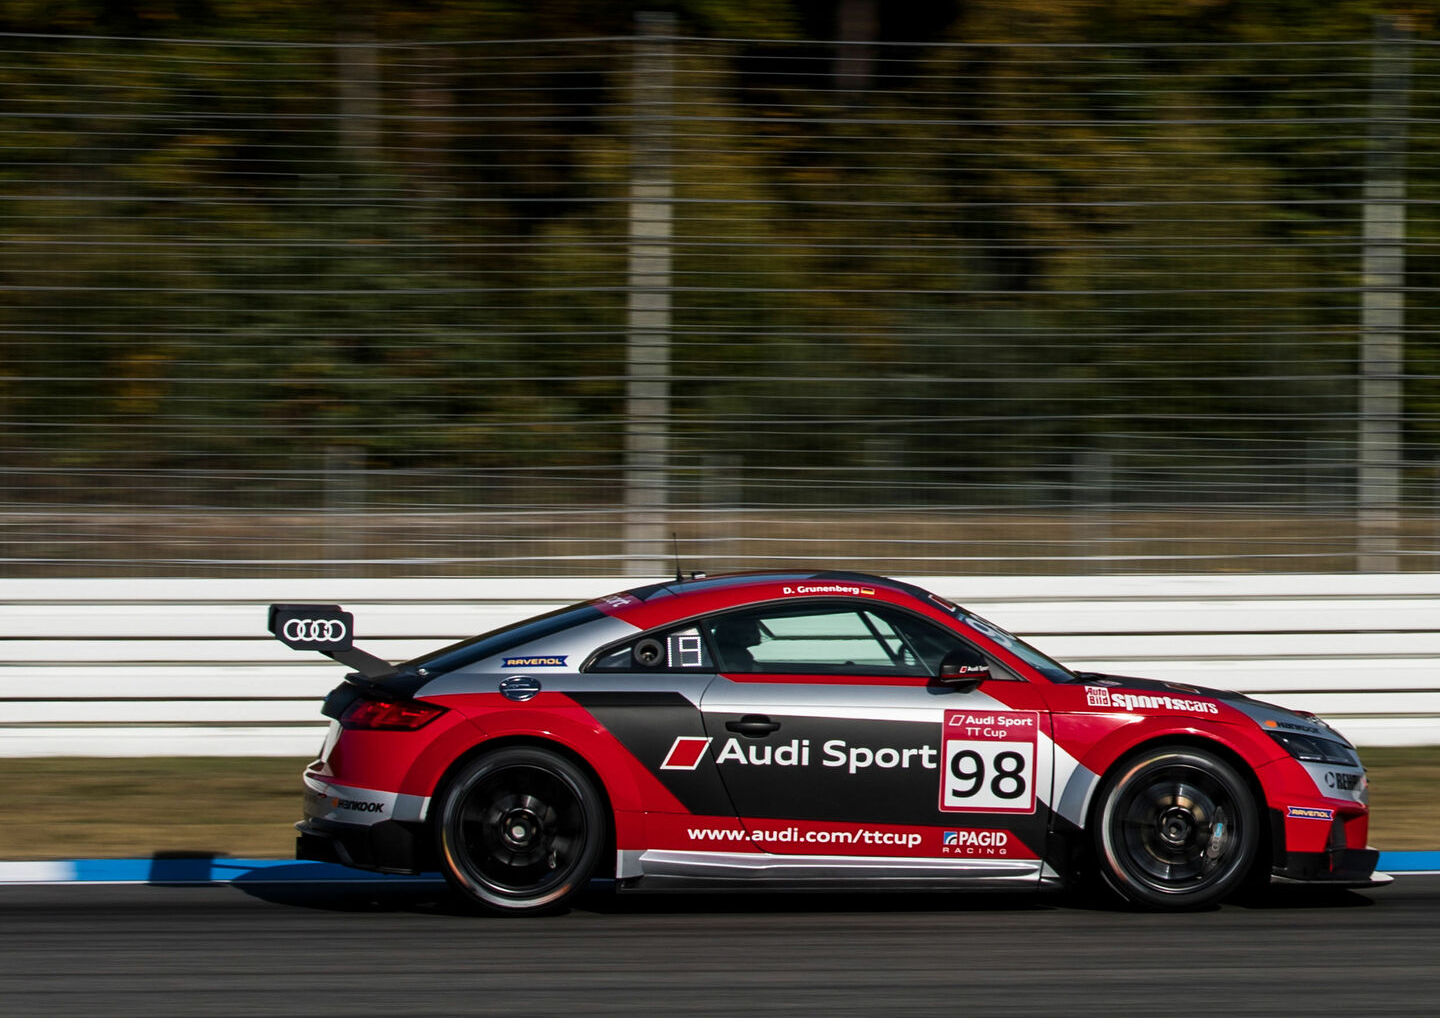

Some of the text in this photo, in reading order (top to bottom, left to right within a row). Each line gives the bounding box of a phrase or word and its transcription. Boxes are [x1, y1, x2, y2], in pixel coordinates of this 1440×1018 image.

[797, 585, 859, 594] Grunenberg
[667, 634, 702, 667] 19
[1086, 687, 1107, 696] Auto
[1089, 696, 1108, 704] Bild
[965, 715, 1033, 727] Audi Sport
[966, 727, 1007, 738] TT Cup
[715, 738, 937, 774] Audi Sport
[950, 749, 1026, 799] 98
[687, 827, 922, 848] www.audi.com/ttcup
[959, 831, 1007, 846] PAGID
[942, 847, 1007, 855] RACING
